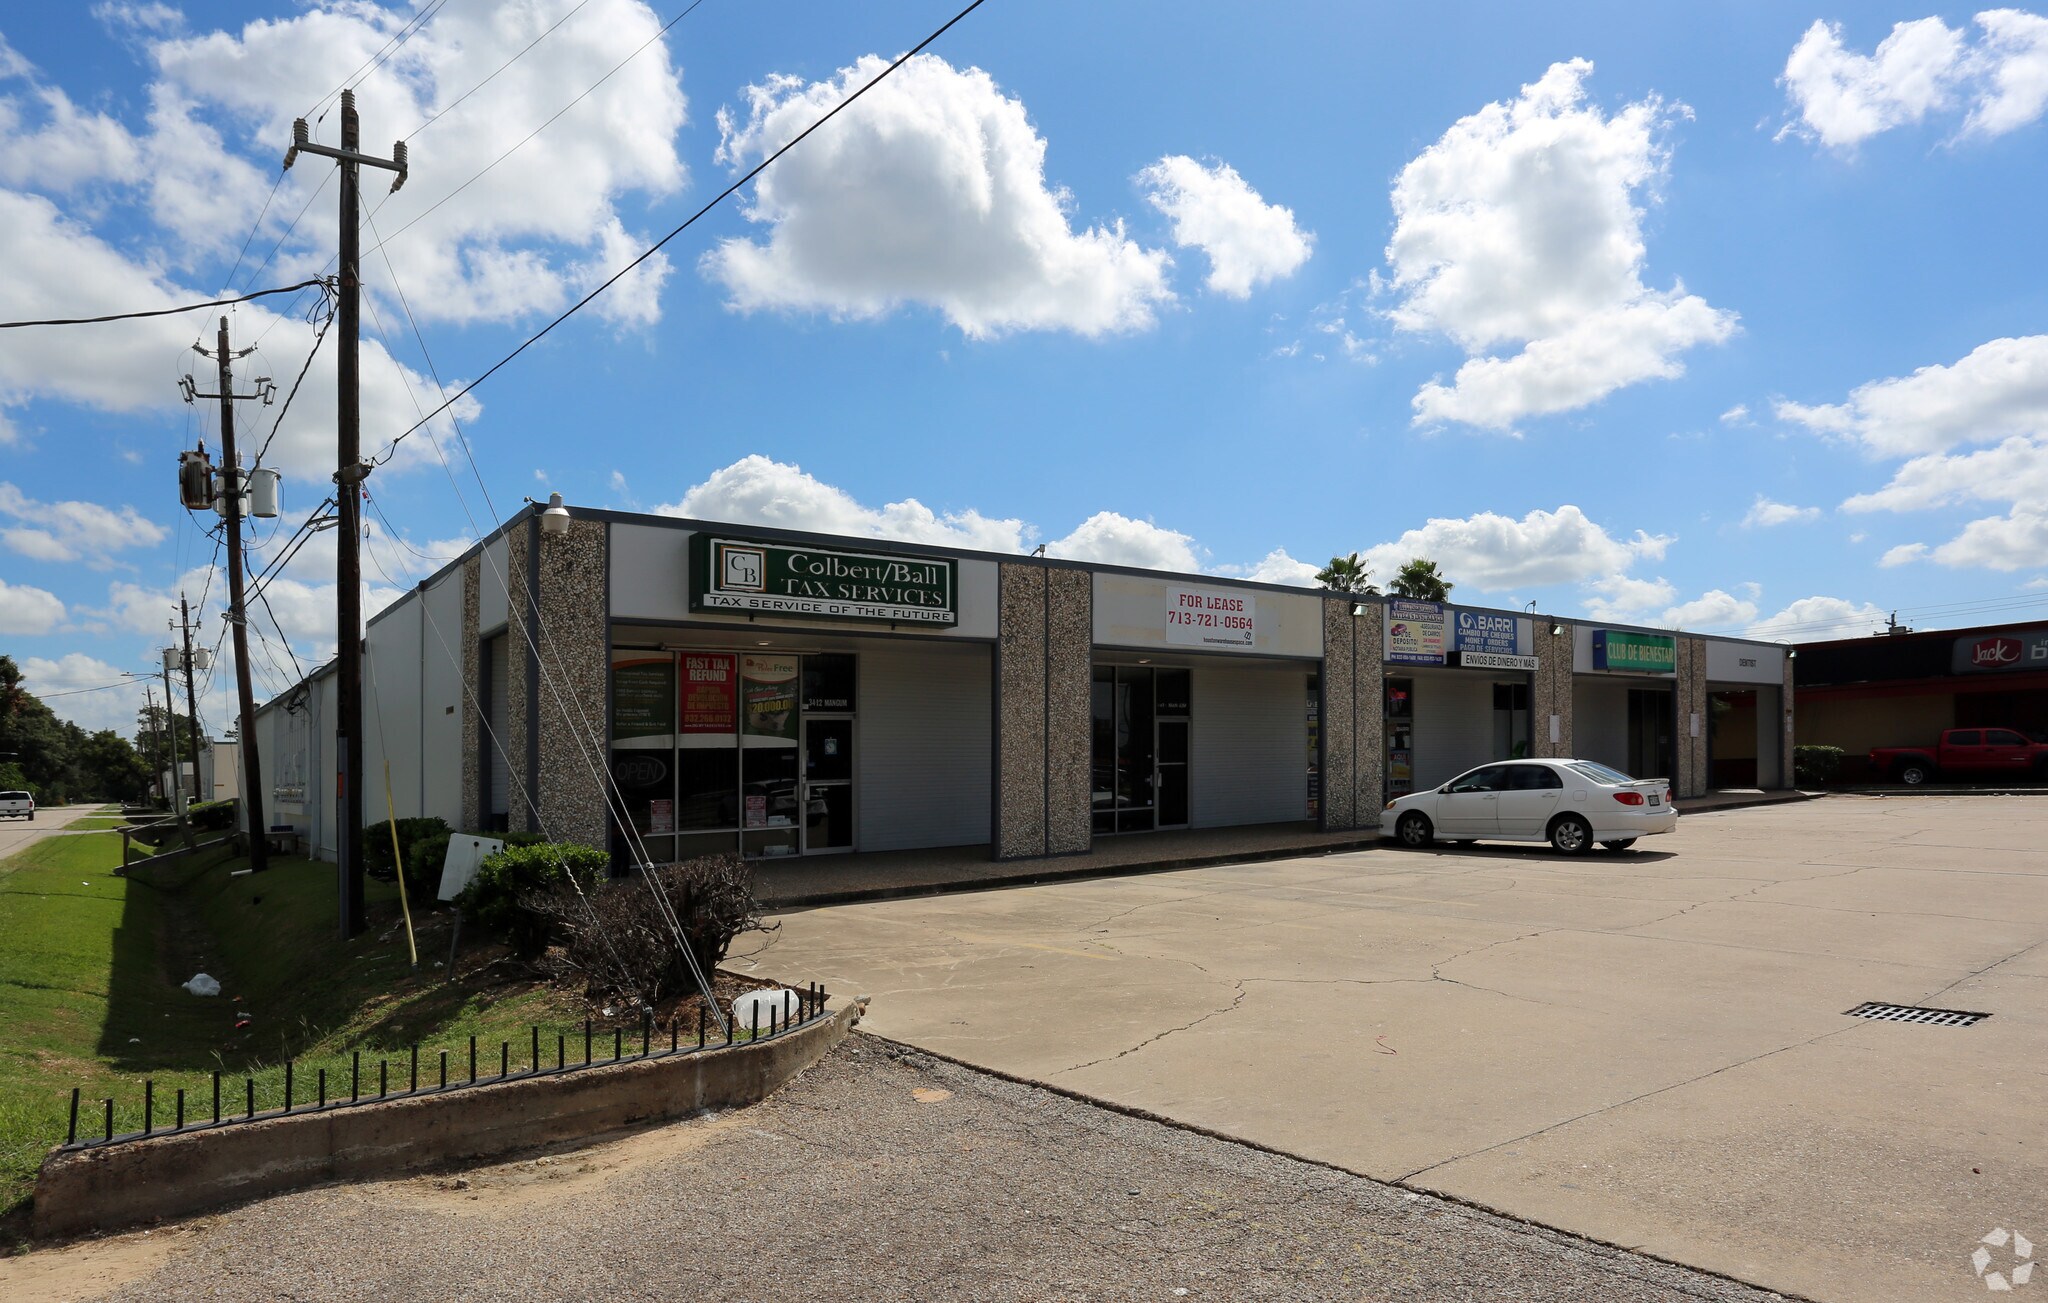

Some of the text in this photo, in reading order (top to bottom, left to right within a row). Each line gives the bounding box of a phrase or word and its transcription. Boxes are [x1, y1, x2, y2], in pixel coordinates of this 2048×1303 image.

[787, 554, 937, 584] Colbert/Ball
[780, 579, 943, 606] TAX SERVICES
[710, 596, 950, 621] TAX SERVICE OF THE FUTURE
[1179, 594, 1243, 612] FOR LEASE
[1168, 611, 1253, 630] 713-721-0564
[1478, 616, 1513, 633] BARRI
[1458, 628, 1514, 640] CAMBIO DE CHEQUES
[1460, 644, 1475, 652] PAGO
[1485, 645, 1513, 655] SERVICIOS
[1487, 638, 1509, 647] ORDERS
[1607, 642, 1674, 664] CLUB DE BIENESTAR
[1972, 639, 2019, 664] Jack
[686, 657, 730, 670] FAST TAX
[773, 664, 793, 672] Free
[1488, 657, 1496, 666] DE
[1497, 657, 1518, 667] DINERO
[1518, 659, 1524, 667] Y
[1739, 658, 1757, 668] DENTIST
[689, 669, 727, 682] REFUND
[808, 698, 823, 707] 3412
[616, 762, 658, 781] OPEN
